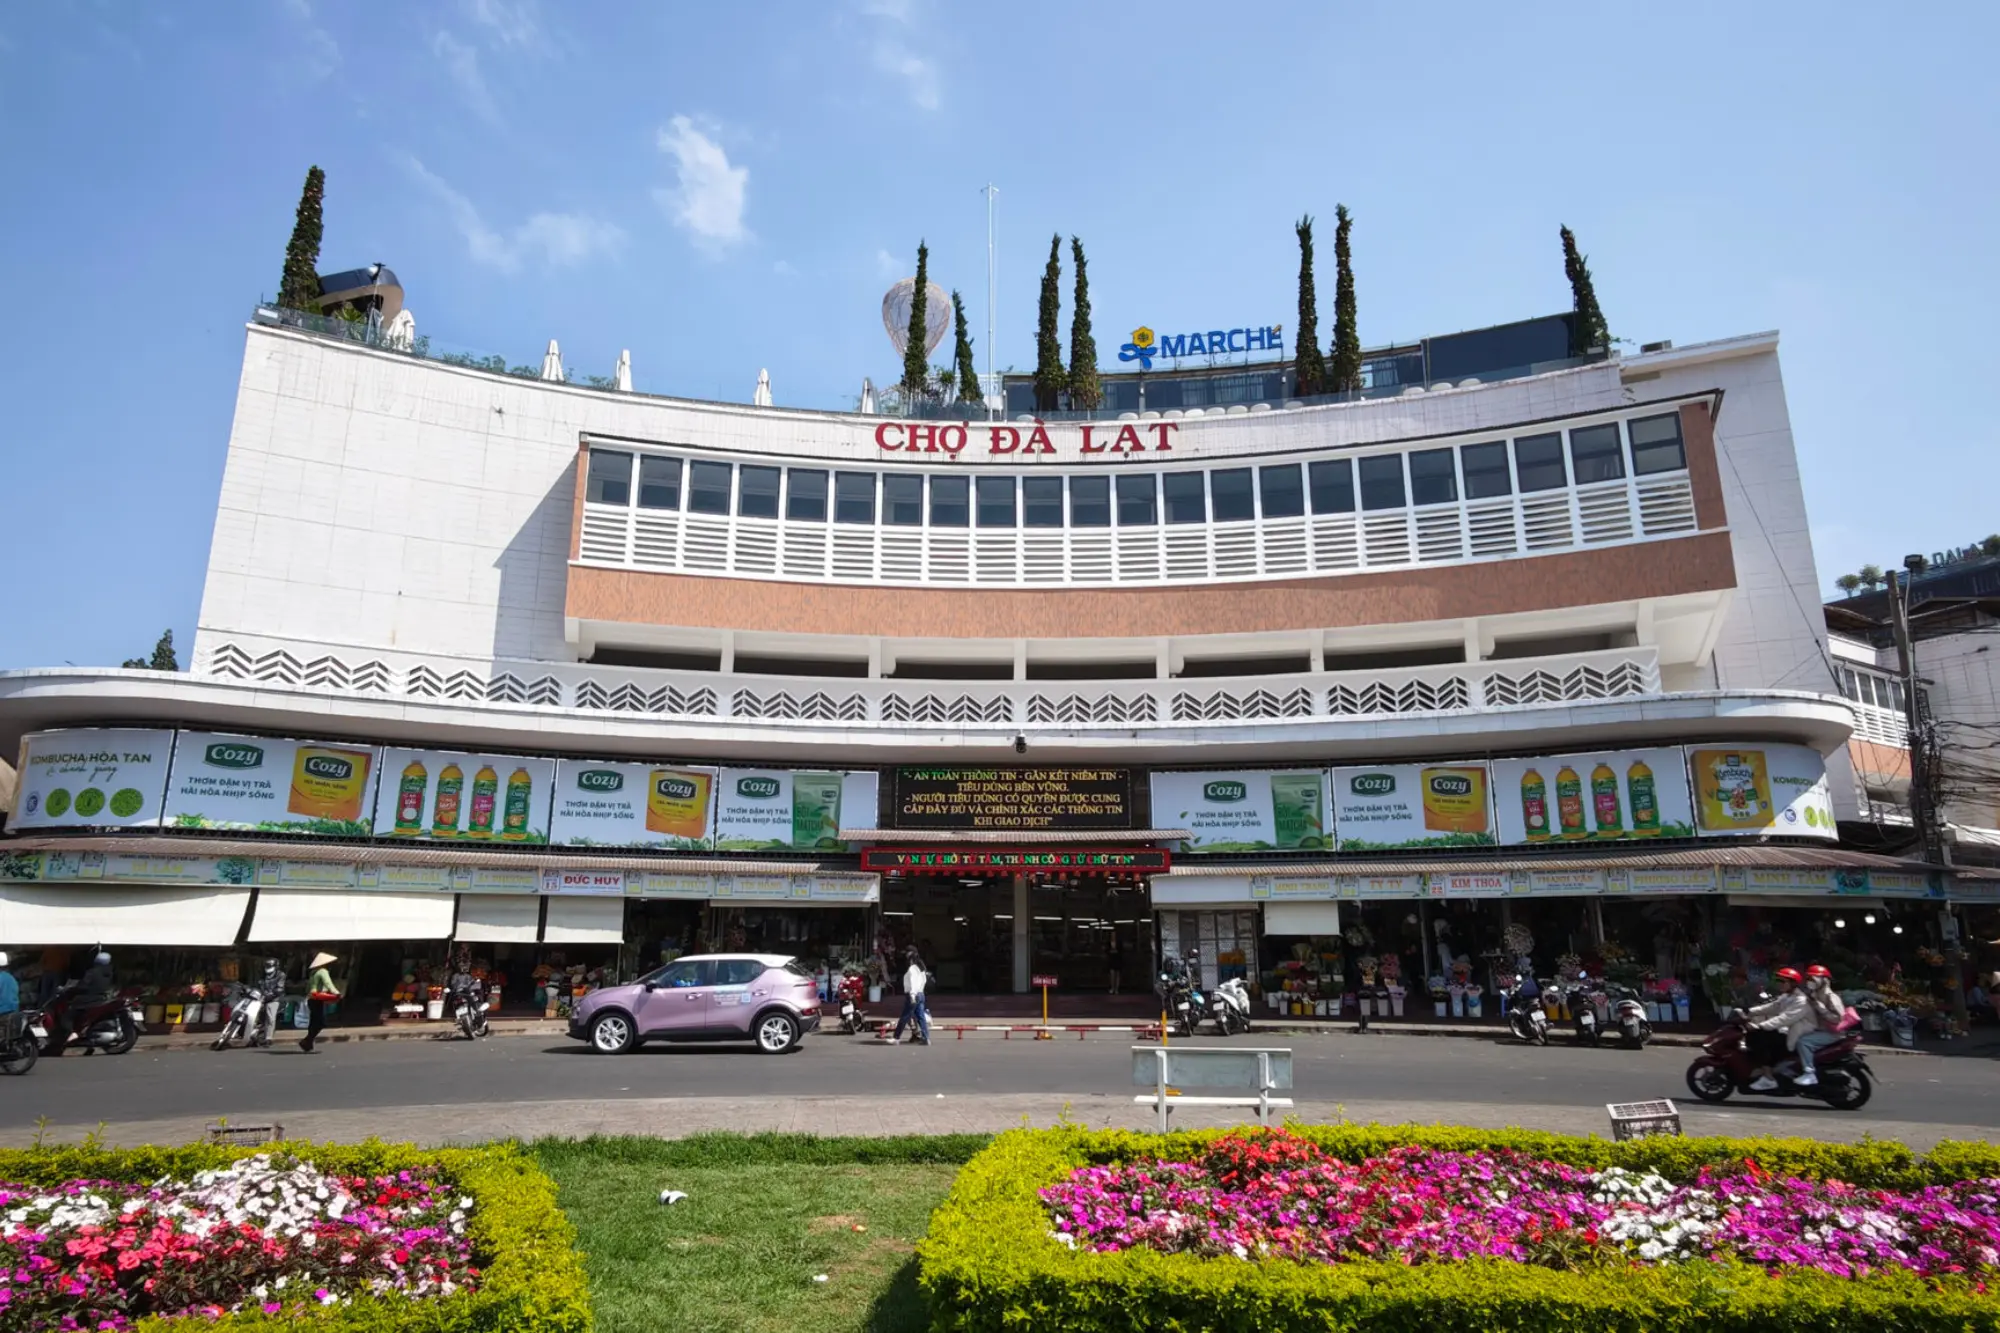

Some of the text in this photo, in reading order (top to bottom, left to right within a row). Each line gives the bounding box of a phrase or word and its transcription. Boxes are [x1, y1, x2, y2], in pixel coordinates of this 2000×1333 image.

[875, 418, 1179, 459] CHỢ ĐÀ LẠT
[30, 750, 151, 765] KOMBUCHA HÒA TAN
[211, 745, 258, 765] Cozy
[308, 758, 349, 777] Cozy
[914, 771, 930, 780] AN
[932, 770, 959, 780] TOÀN
[962, 769, 997, 780] THÔNG
[1000, 771, 1017, 780] TIN
[1099, 771, 1116, 780] TIN
[582, 772, 619, 789] Cozy
[741, 780, 776, 795] Cozy
[957, 781, 981, 791] TIÊU
[983, 781, 1012, 791] DÙNG
[1354, 777, 1391, 791] Cozy
[1433, 779, 1467, 793] Cozy
[660, 780, 692, 797] Cozy
[1207, 784, 1242, 798] Cozy
[911, 793, 945, 802] NGƯỜI
[948, 792, 971, 802] TIÊU
[973, 793, 1002, 802] DÙNG
[1005, 793, 1019, 802] CÓ
[1091, 794, 1120, 802] CUNG
[968, 804, 983, 814] VÀ
[985, 804, 1018, 814] CHÍNH
[1020, 804, 1042, 814] XÁC
[1043, 804, 1066, 814] CÁC
[1067, 804, 1103, 814] THÔNG
[1105, 805, 1123, 814] TIN
[974, 817, 992, 825] KHI
[994, 817, 1021, 825] GIAO
[564, 873, 620, 885] ĐỨC HUY
[1451, 878, 1502, 888] KIM THOA
